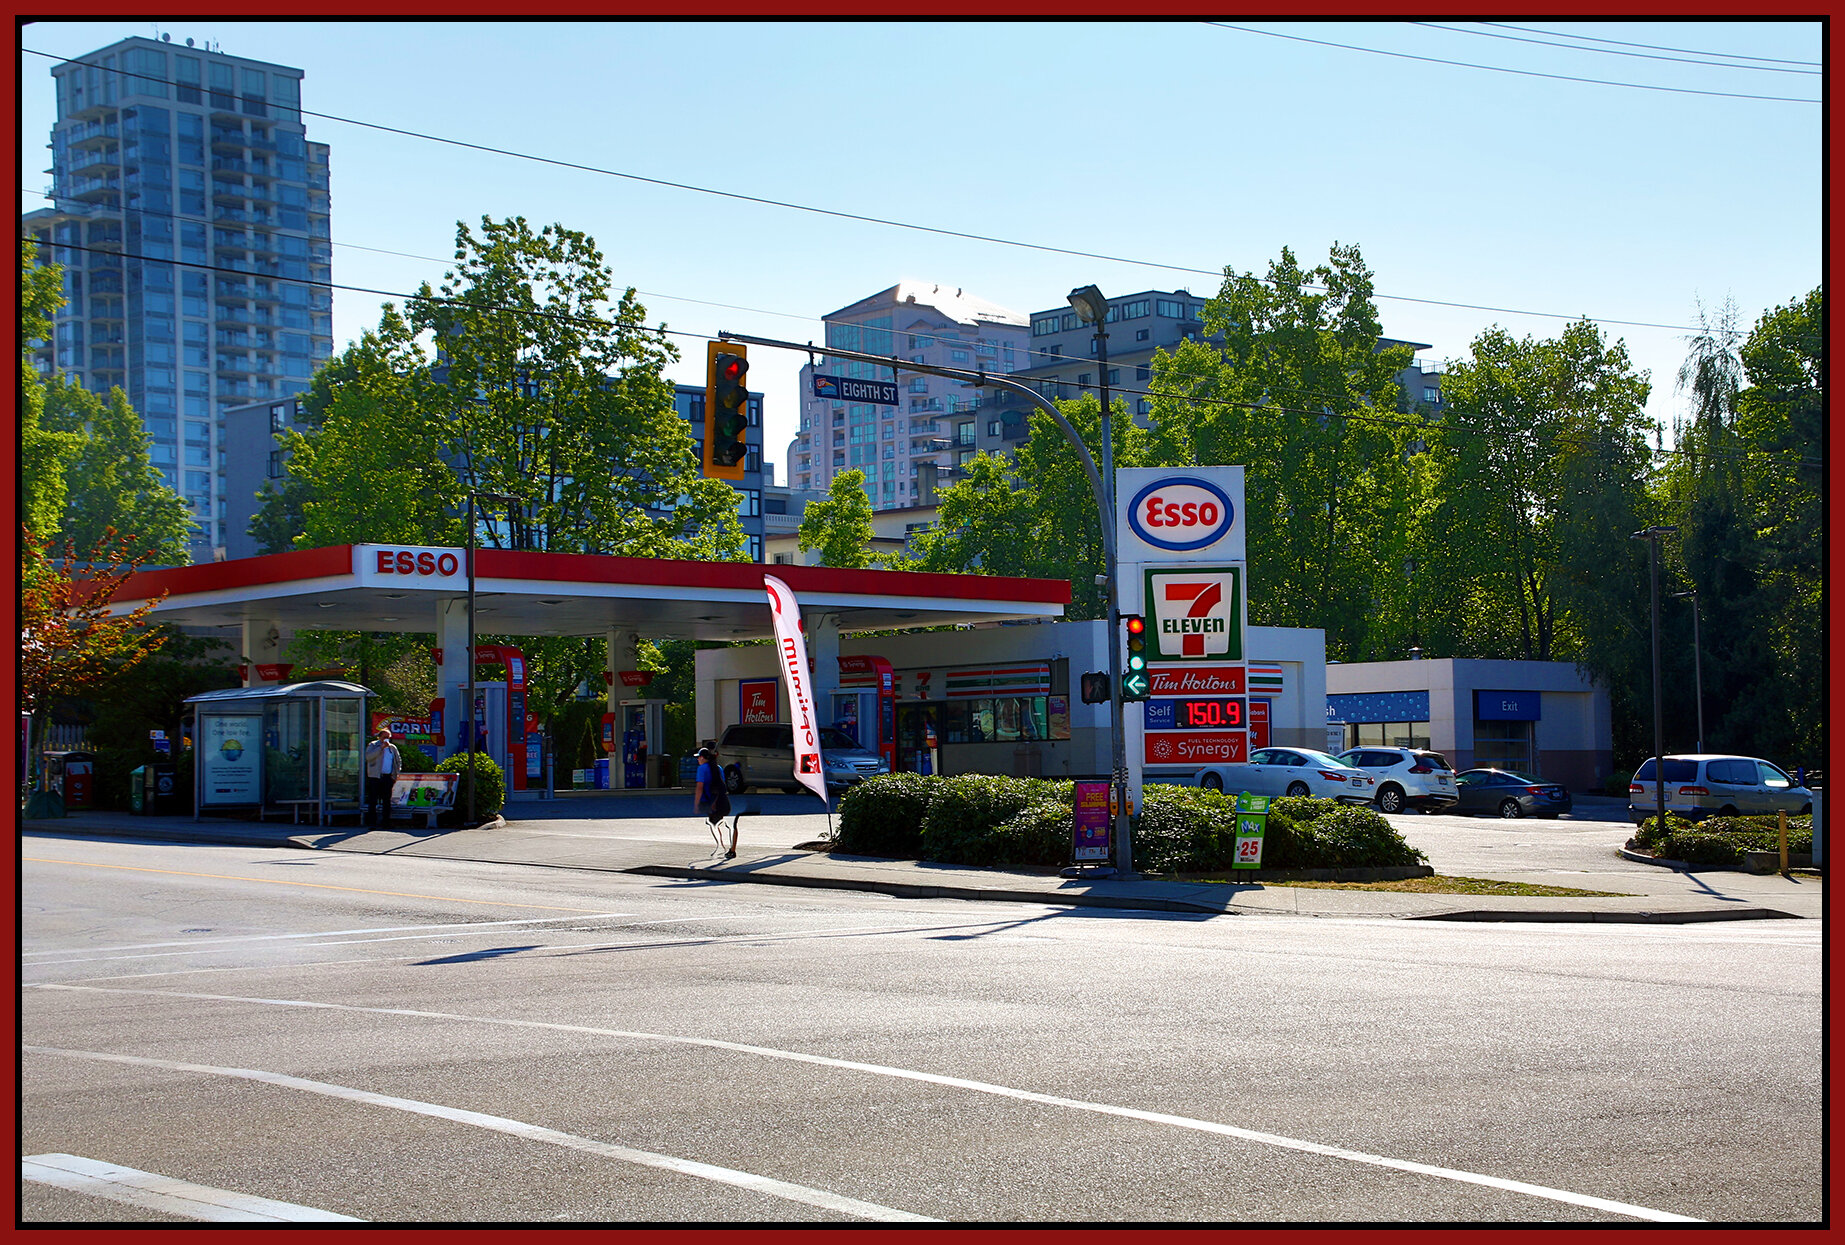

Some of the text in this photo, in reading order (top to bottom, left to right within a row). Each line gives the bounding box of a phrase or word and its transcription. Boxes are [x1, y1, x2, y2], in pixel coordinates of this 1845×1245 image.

[842, 382, 896, 401] EIGHTH ST
[1146, 497, 1218, 527] Esso
[377, 551, 458, 576] ESSO
[1165, 582, 1221, 656] 7
[1152, 672, 1237, 690] Tim Hortons
[745, 692, 774, 722] Tim Hortons
[1149, 702, 1240, 725] Self 150.9
[1502, 701, 1518, 711] Exit
[390, 722, 425, 734] CAR
[1177, 742, 1239, 758] Synergy
